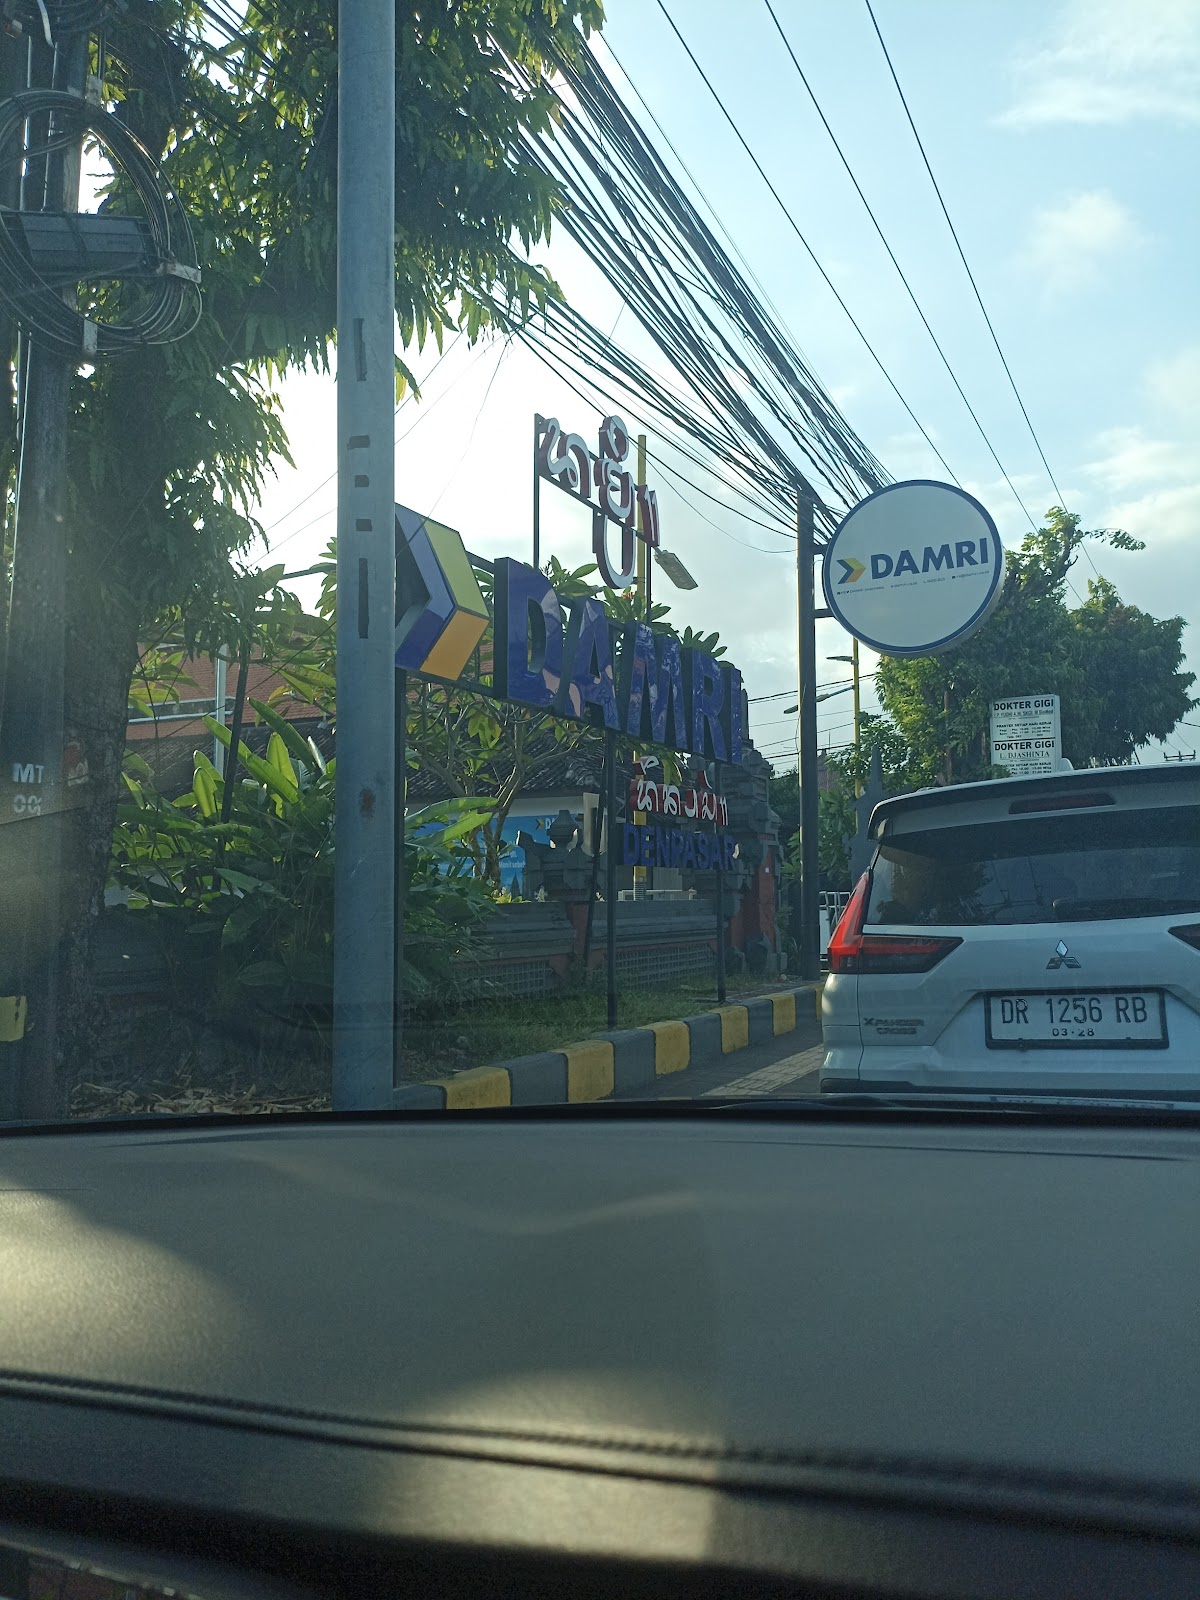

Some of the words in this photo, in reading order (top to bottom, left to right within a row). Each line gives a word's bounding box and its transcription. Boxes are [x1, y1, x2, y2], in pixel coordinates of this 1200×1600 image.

[871, 538, 989, 580] DAMRI
[494, 557, 745, 765] DAMRI
[994, 701, 1031, 711] DOKTER
[1034, 699, 1054, 708] GIGI
[994, 742, 1032, 751] DOKTER
[1034, 740, 1055, 749] GIGI
[623, 823, 736, 872] DENPASAR
[1001, 998, 1030, 1025] DR
[1045, 997, 1103, 1025] 1256
[1115, 996, 1148, 1024] RB
